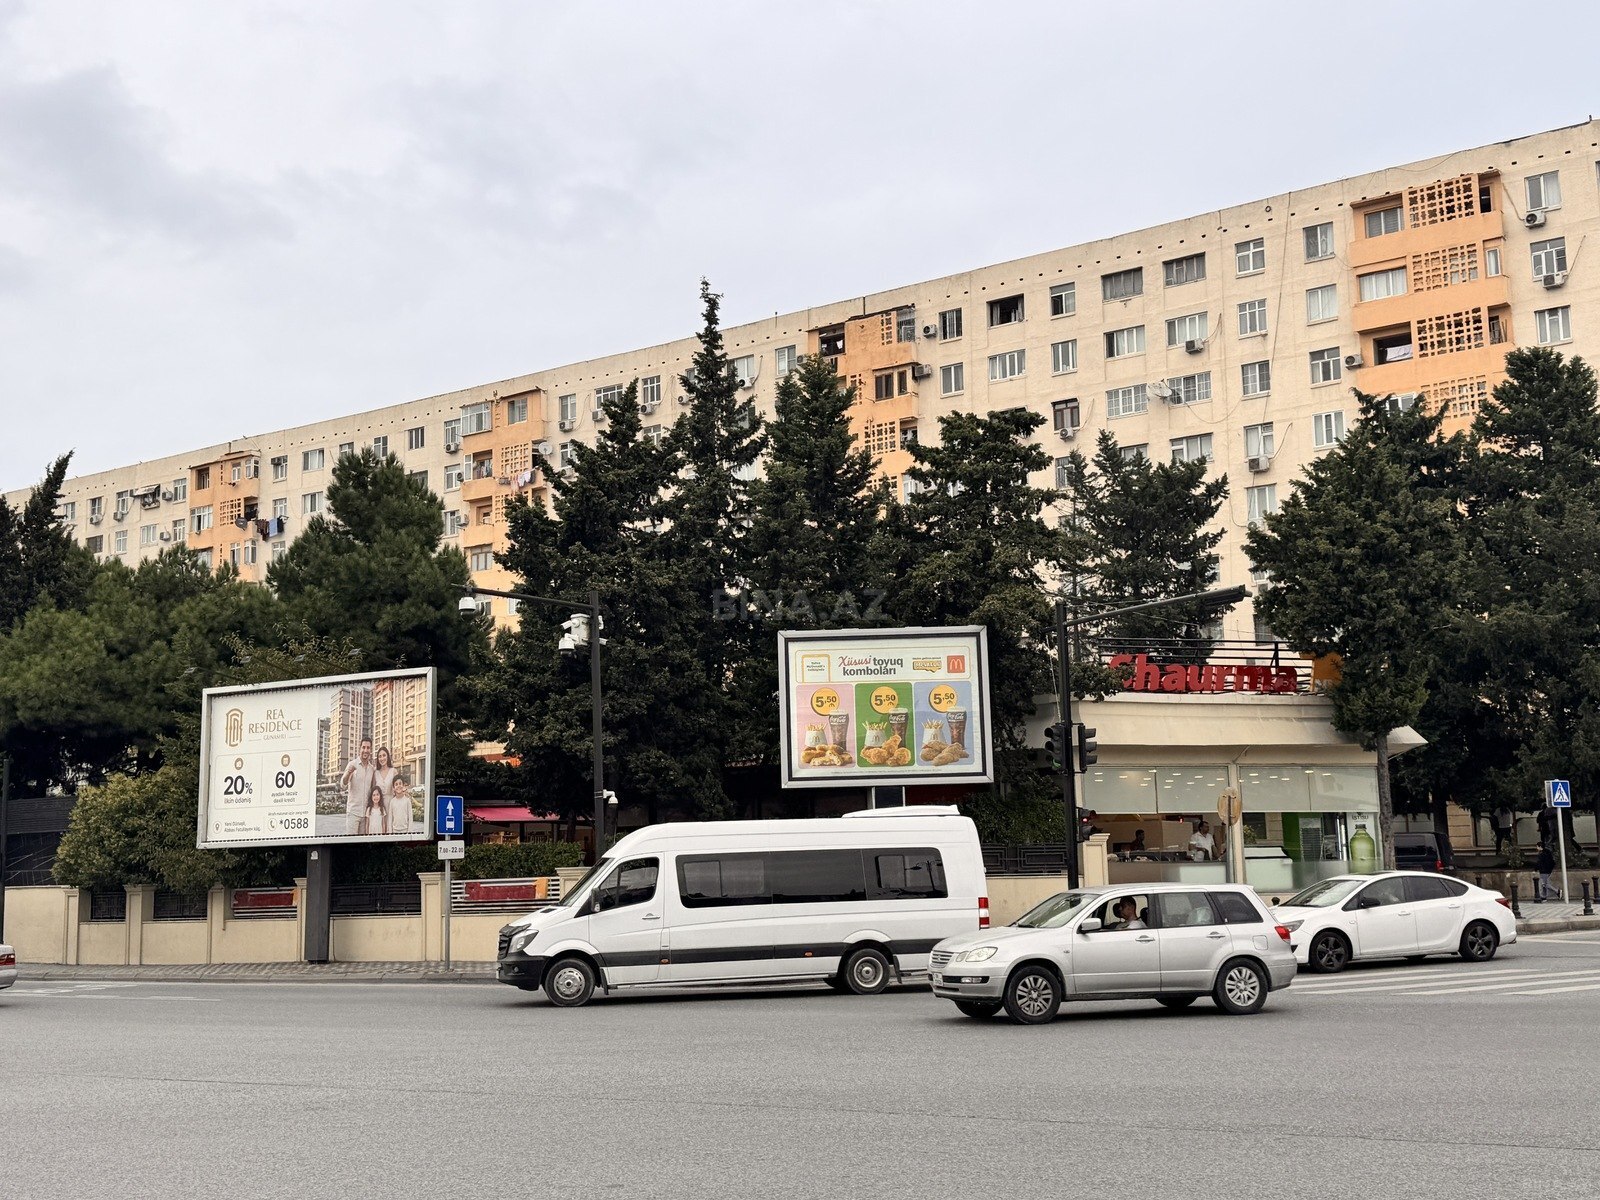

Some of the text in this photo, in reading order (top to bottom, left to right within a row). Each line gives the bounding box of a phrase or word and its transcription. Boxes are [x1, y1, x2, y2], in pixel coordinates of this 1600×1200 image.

[838, 655, 872, 668] Xüsusi
[873, 657, 904, 668] toyuq
[842, 666, 897, 676] komboları
[266, 709, 285, 720] REA
[248, 719, 303, 734] RESIDENCE
[223, 775, 253, 796] 20%
[275, 770, 296, 789] 60
